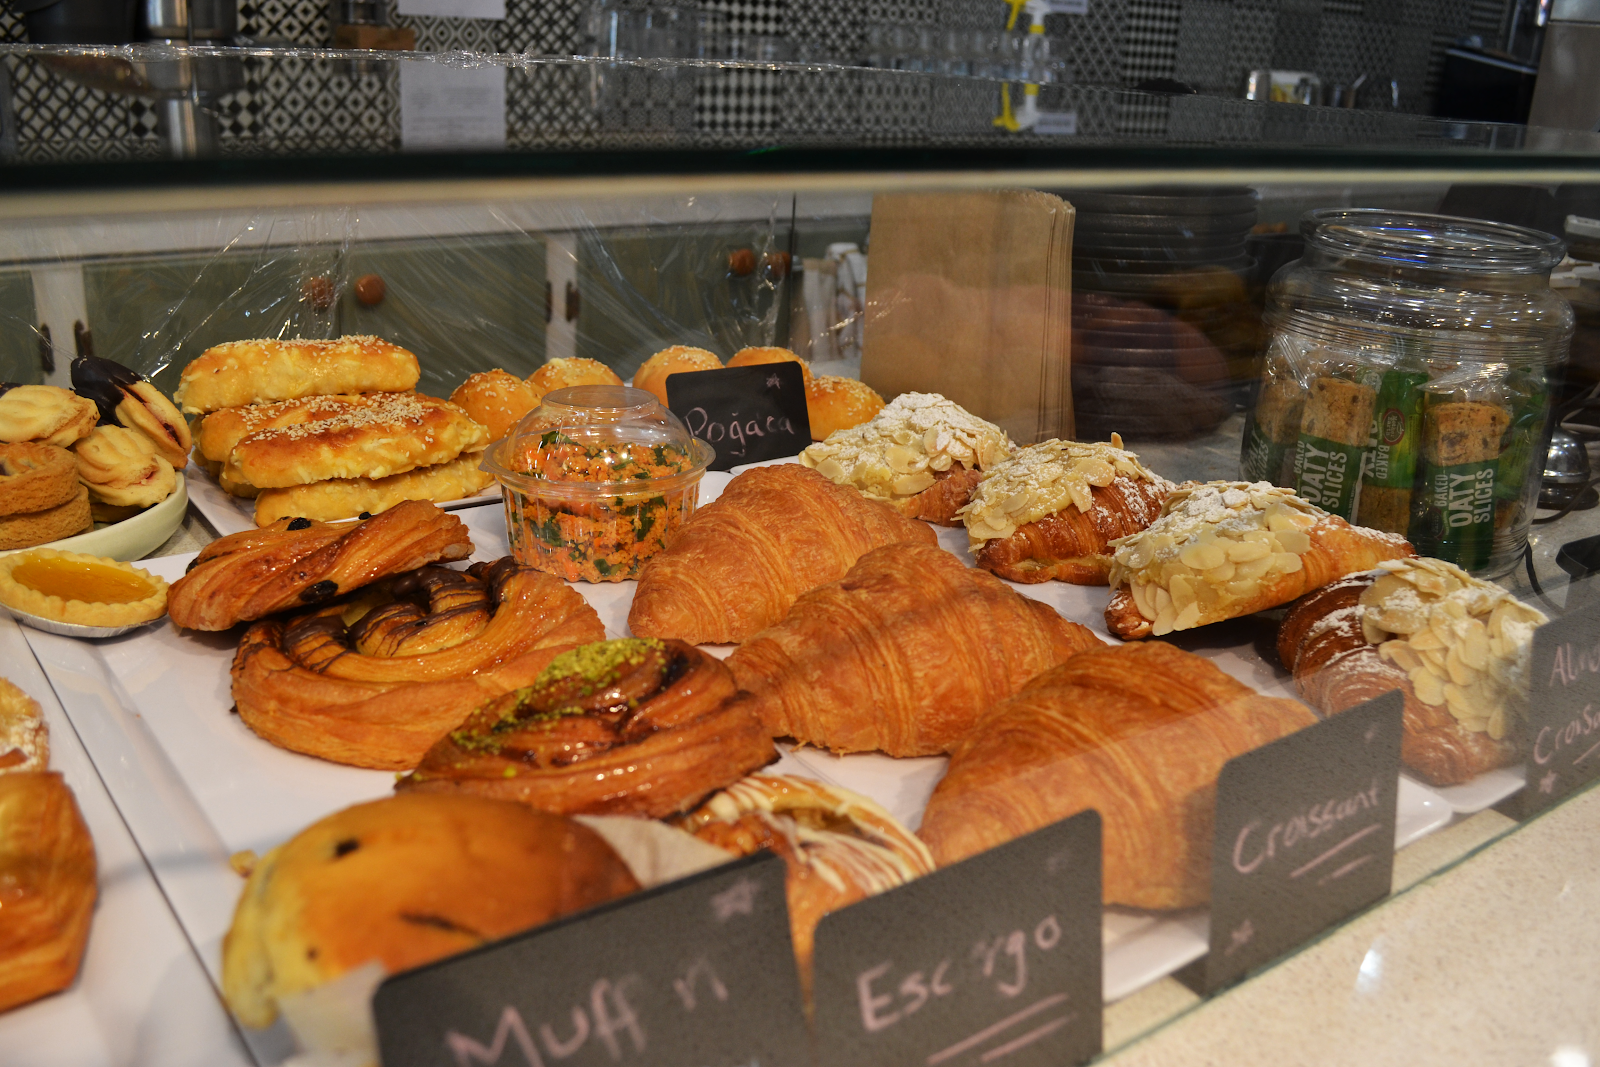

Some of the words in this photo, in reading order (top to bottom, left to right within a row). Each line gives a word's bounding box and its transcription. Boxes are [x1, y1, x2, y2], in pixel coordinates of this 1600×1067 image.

[1301, 443, 1330, 503] OATY
[1322, 451, 1348, 508] SLICES
[1376, 445, 1390, 479] BAKED
[1434, 475, 1448, 507] BAKED
[1448, 473, 1476, 527] OATY
[1473, 468, 1494, 524] SLICES
[1233, 777, 1379, 873] Croissant
[857, 914, 1062, 1034] Escrgo
[444, 956, 729, 1067] Muffn
